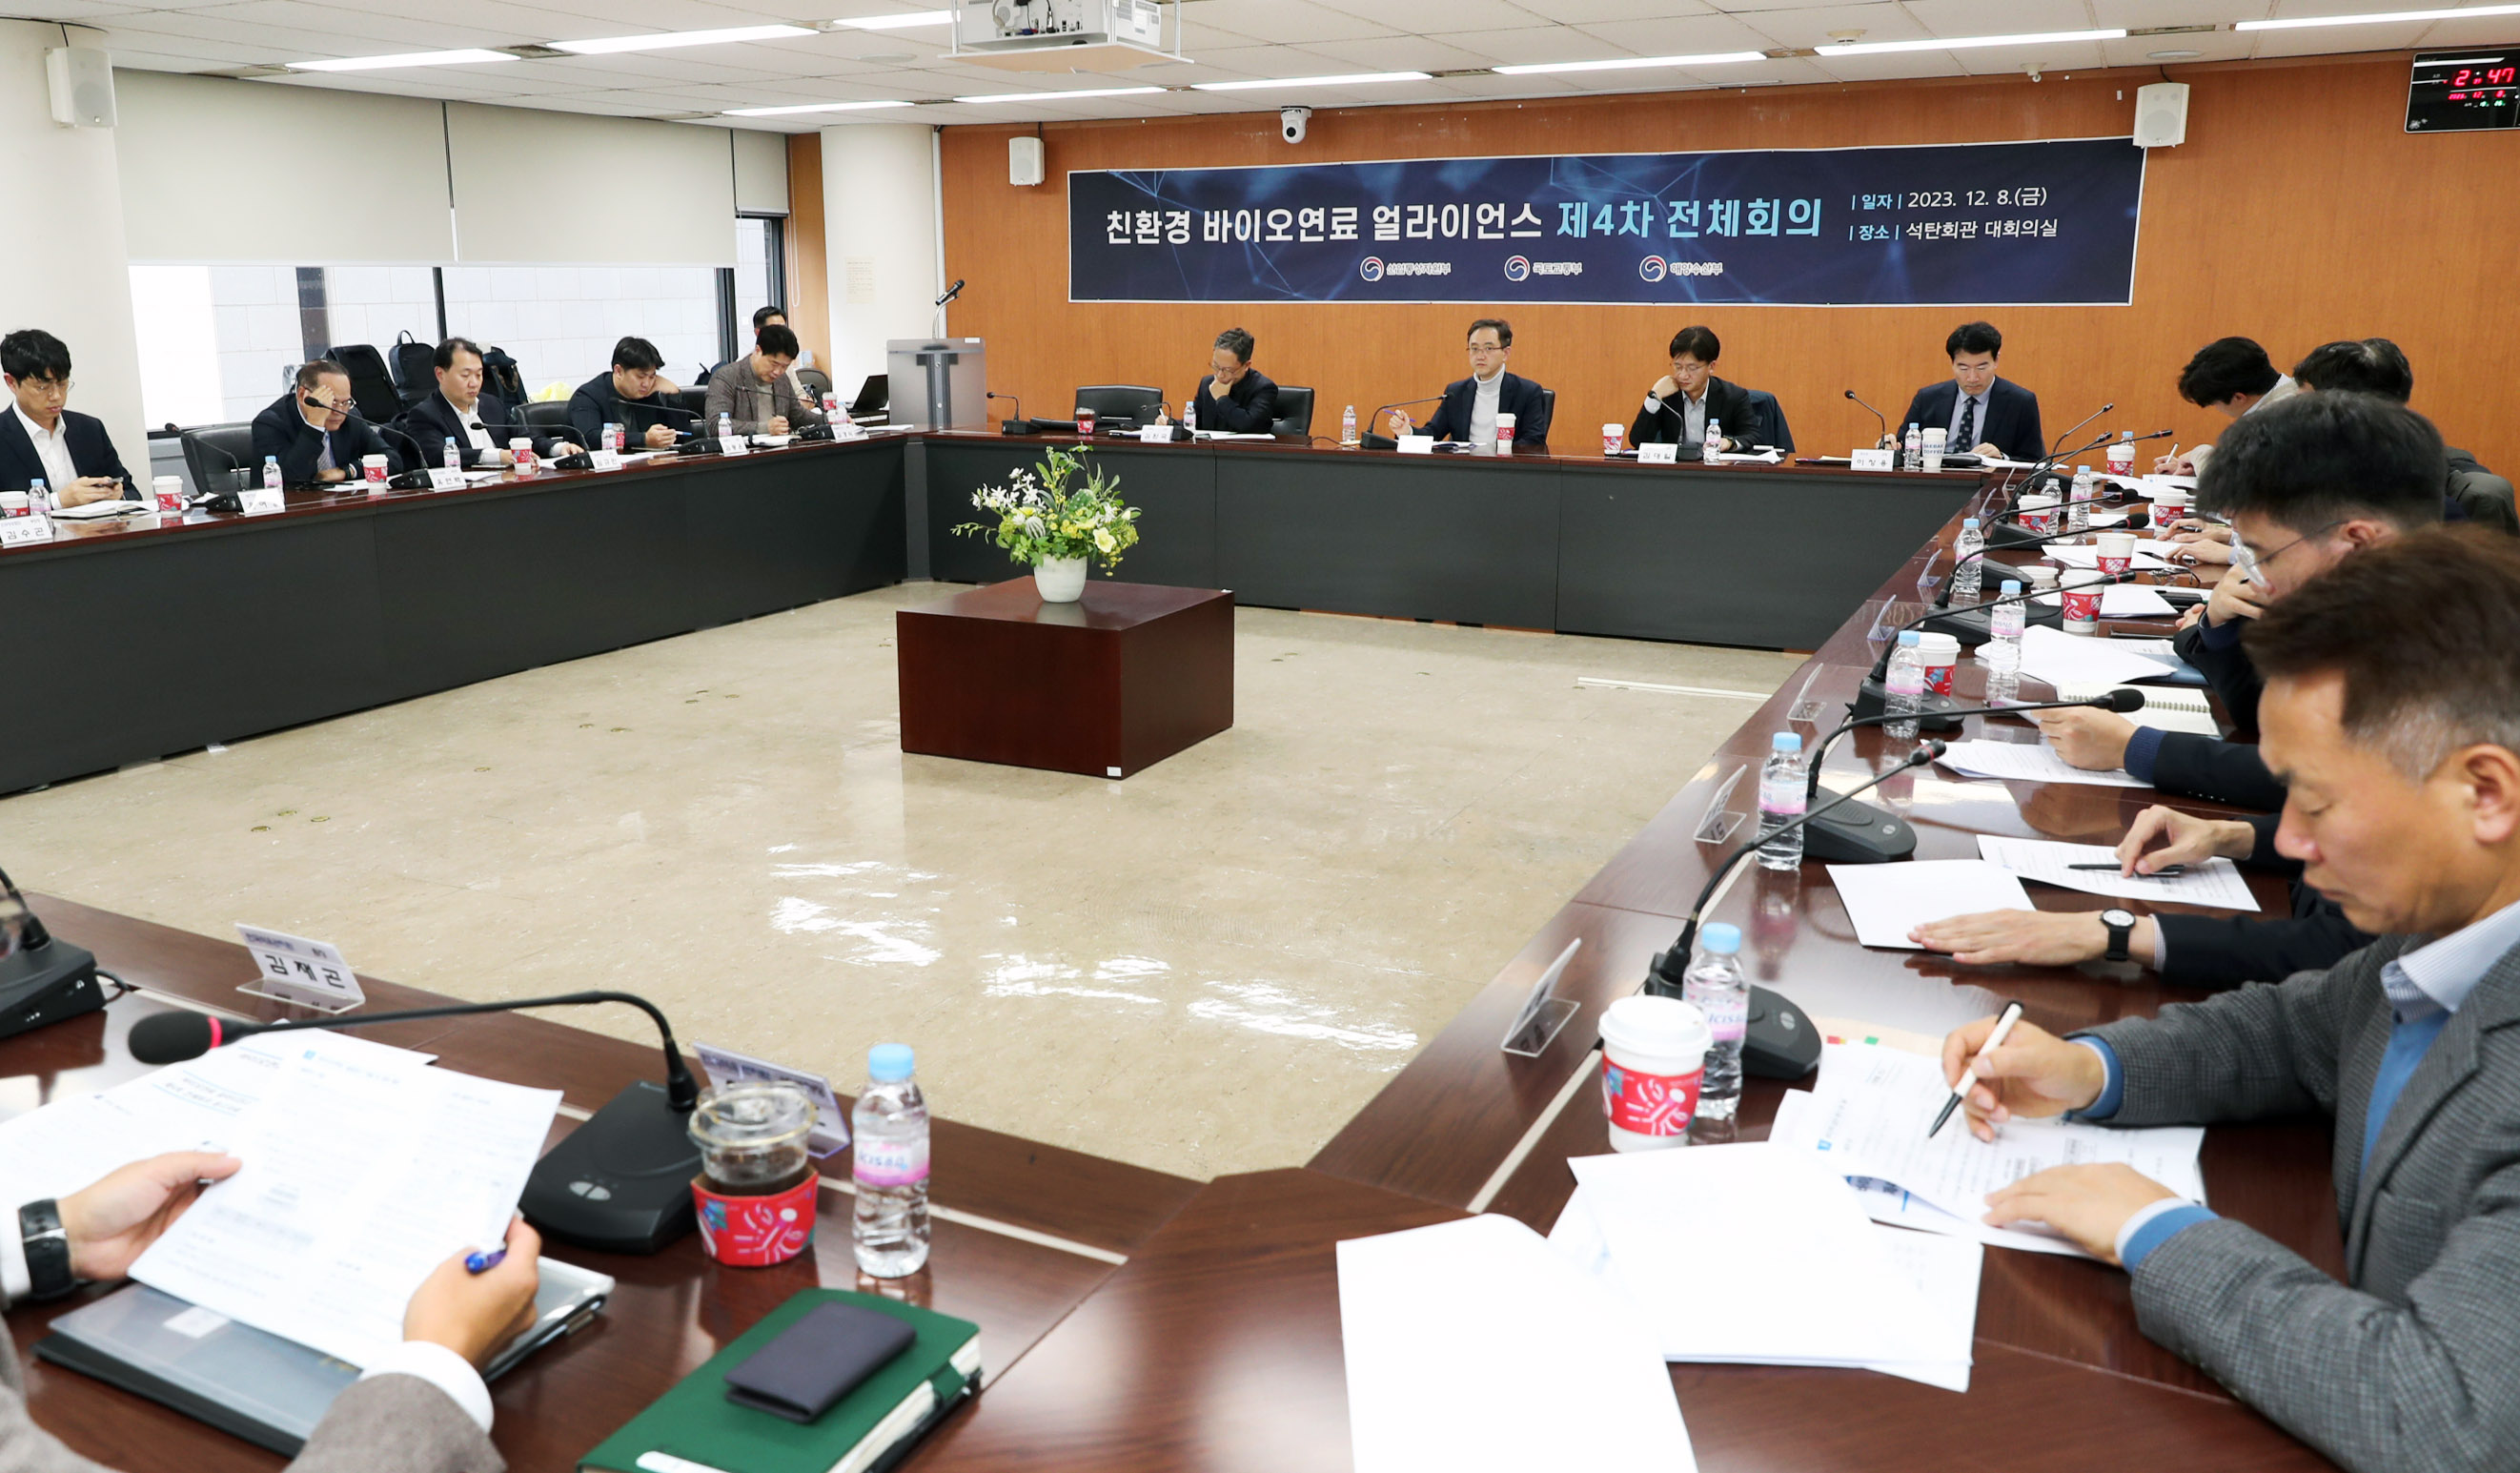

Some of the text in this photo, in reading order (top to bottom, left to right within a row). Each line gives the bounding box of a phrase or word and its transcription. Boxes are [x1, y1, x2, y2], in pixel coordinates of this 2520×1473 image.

[1861, 194, 1893, 210] 일자
[1907, 192, 1957, 208] 2023.
[1965, 190, 1989, 206] 12.
[1107, 197, 1822, 244] 친환경 바이오연료 얼라이언스 제4차 전체회의
[1859, 218, 2059, 240] 장소 석탄회관 대회의실
[1387, 262, 1451, 276] 산업통상자원부
[1533, 262, 1582, 276] 국토교통부
[1670, 262, 1723, 276] 해양수산부
